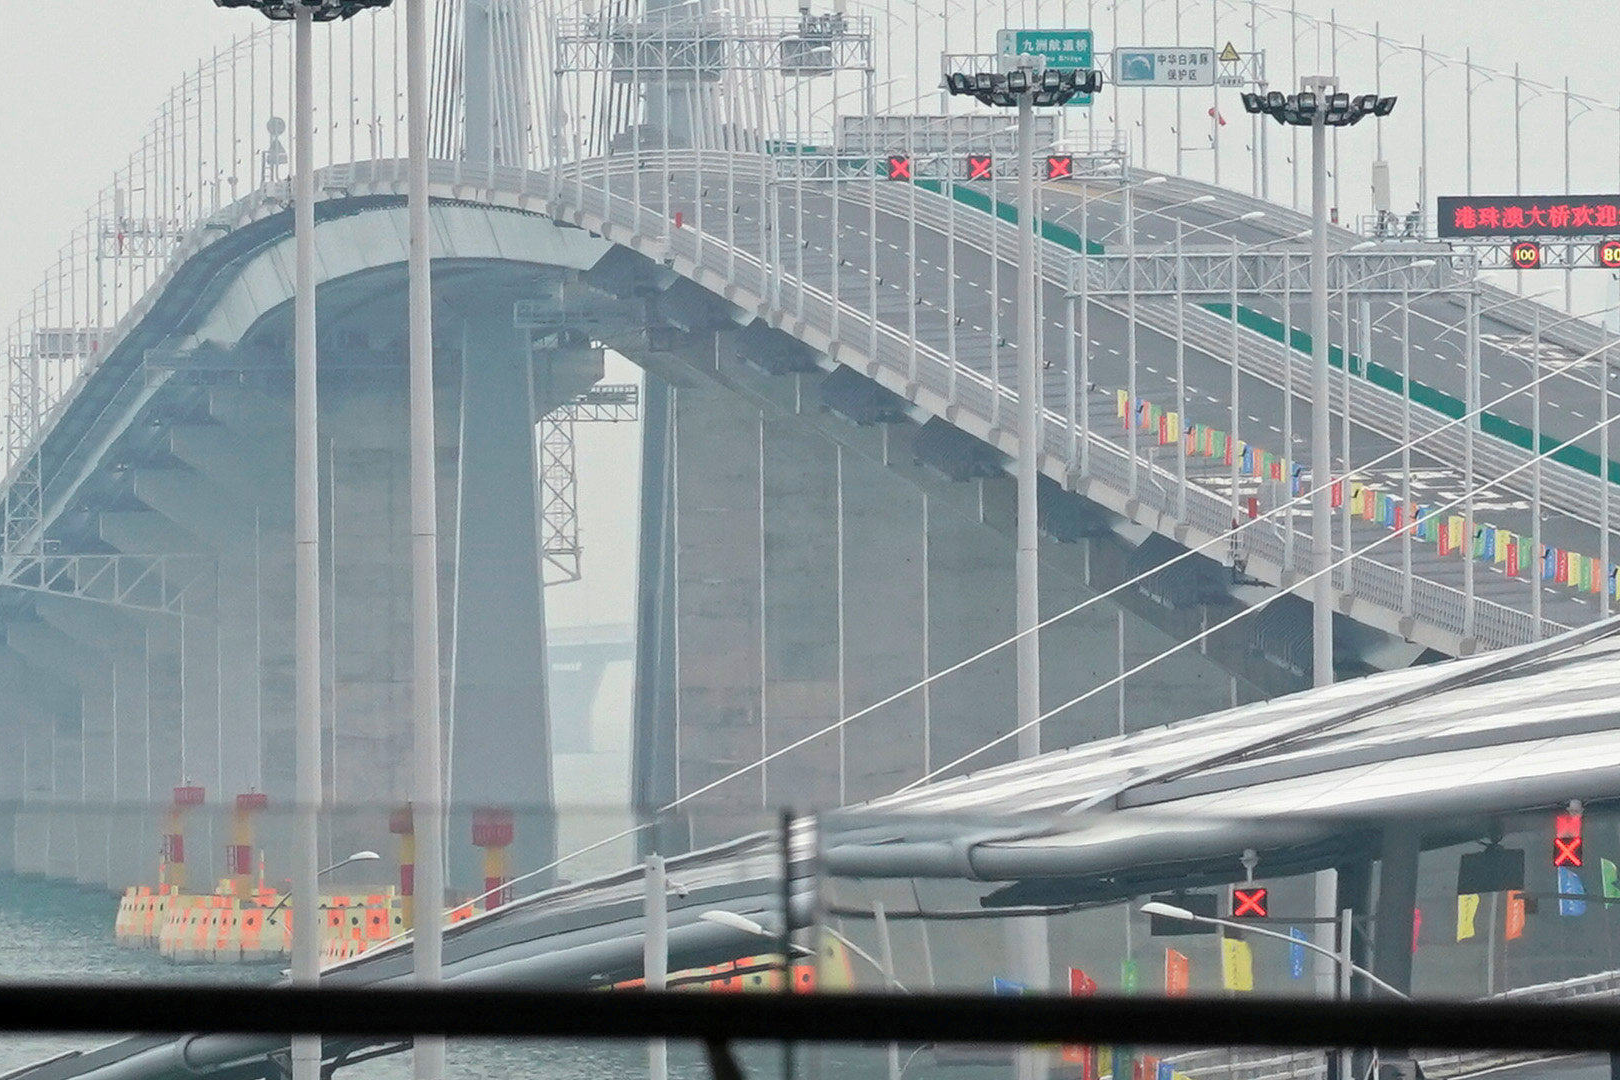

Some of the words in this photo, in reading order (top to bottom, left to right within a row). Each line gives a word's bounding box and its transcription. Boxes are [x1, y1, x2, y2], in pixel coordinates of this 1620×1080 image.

[1454, 204, 1620, 229] 港珠澳大桥欢迎
[1514, 248, 1536, 262] 100
[1603, 248, 1620, 262] 80
